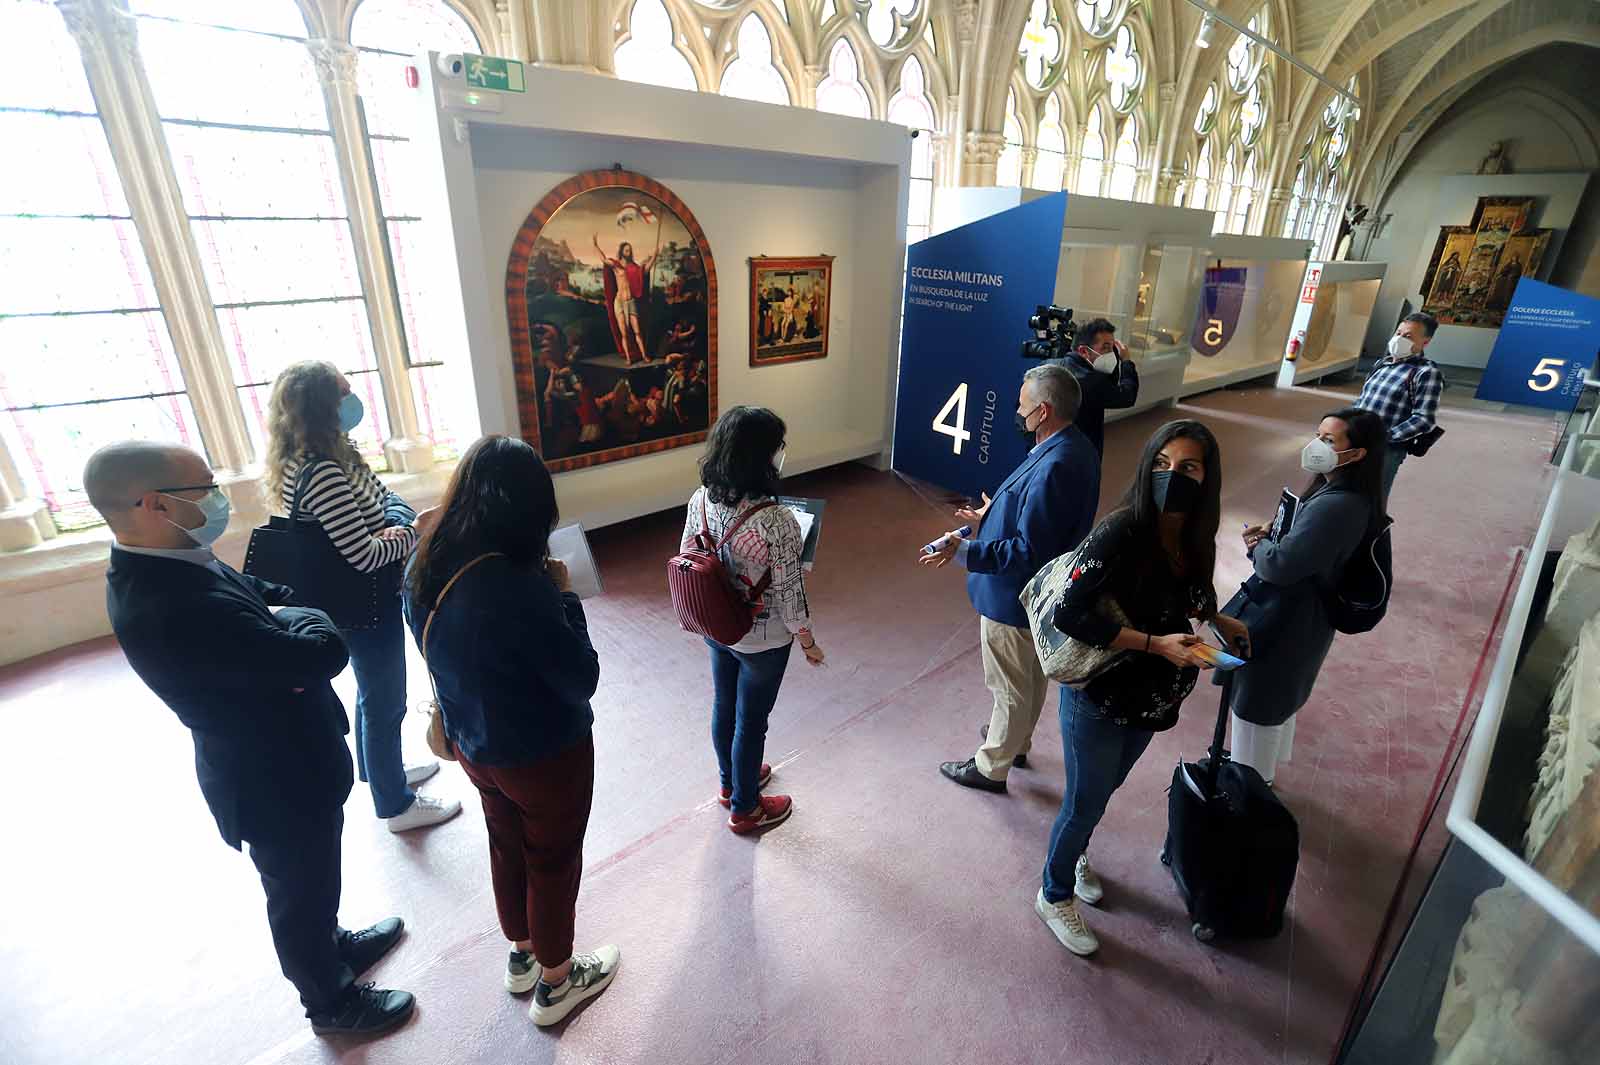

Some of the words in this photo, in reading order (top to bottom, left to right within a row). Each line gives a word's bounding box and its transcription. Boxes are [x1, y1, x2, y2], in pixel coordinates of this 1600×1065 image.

[911, 266, 953, 281] ECCLESIA
[955, 271, 1003, 287] MILITANS
[954, 290, 963, 299] DE
[964, 292, 973, 301] LA
[974, 293, 988, 302] LUZ
[945, 302, 955, 310] THE
[956, 303, 973, 312] LIGHT
[1513, 306, 1540, 314] DOLENS
[1528, 358, 1564, 392] 5
[932, 382, 971, 455] 4
[978, 390, 997, 465] CAPÍTULO
